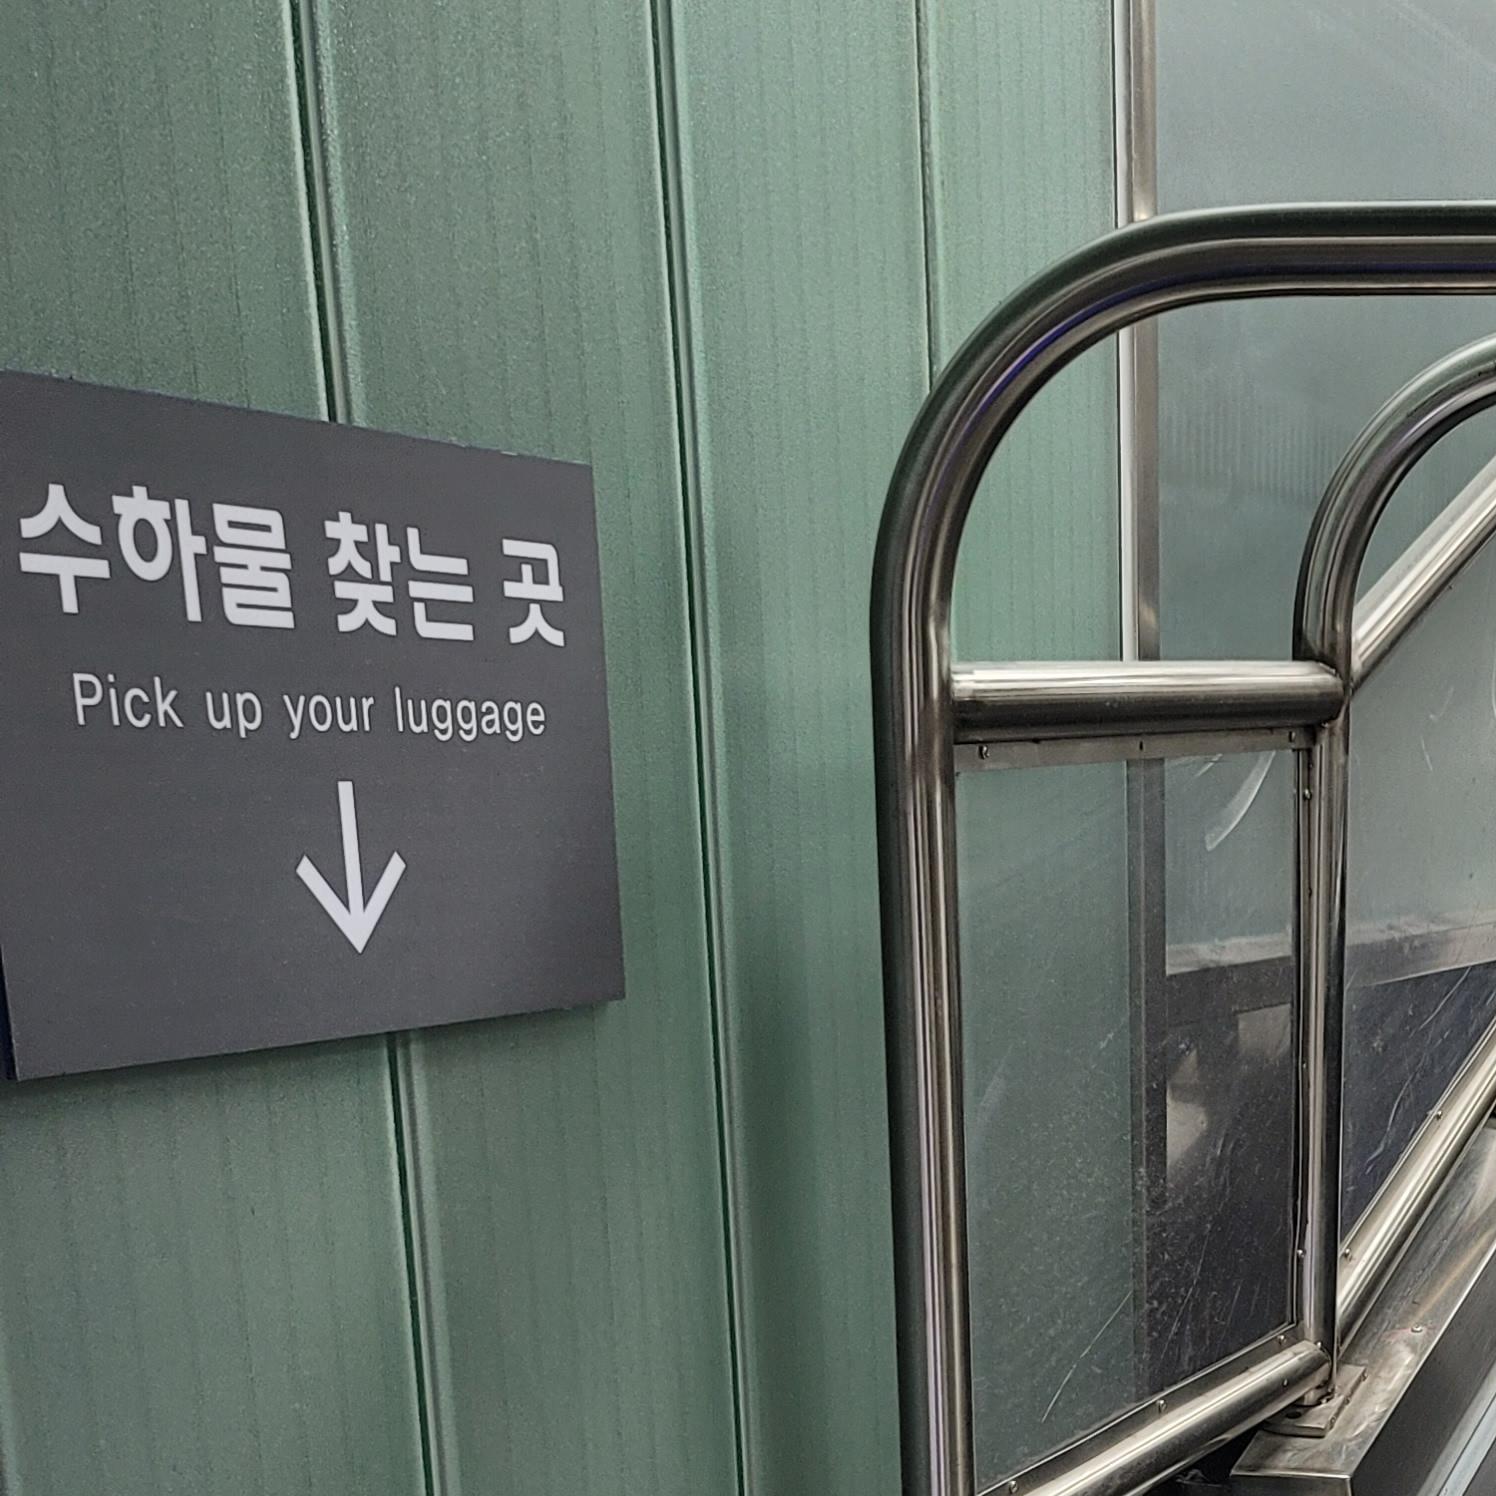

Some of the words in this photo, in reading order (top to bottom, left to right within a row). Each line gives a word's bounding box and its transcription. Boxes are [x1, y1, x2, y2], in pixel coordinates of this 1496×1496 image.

[19, 483, 295, 629] 수하물
[324, 511, 475, 641] 찾는
[502, 538, 565, 647] 곳
[72, 672, 184, 728] Pick
[205, 691, 262, 738] up
[283, 693, 374, 739] your
[394, 686, 546, 742] luggage
